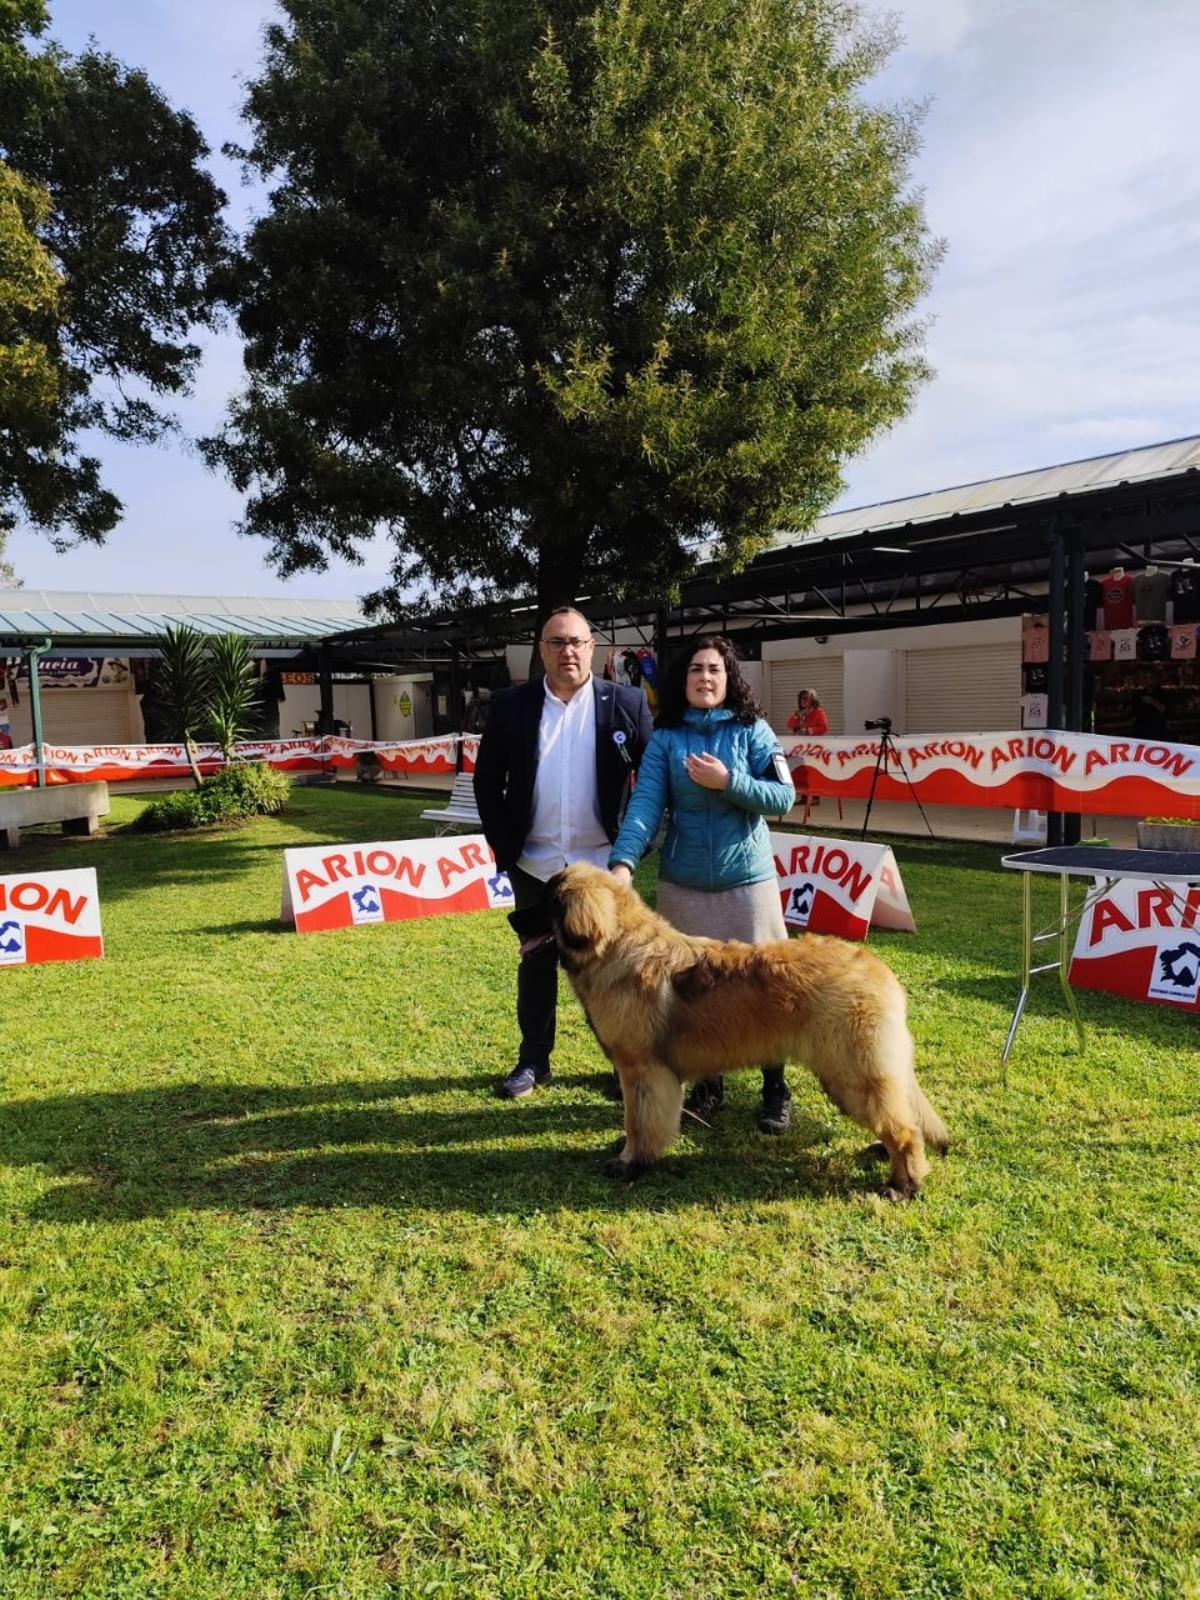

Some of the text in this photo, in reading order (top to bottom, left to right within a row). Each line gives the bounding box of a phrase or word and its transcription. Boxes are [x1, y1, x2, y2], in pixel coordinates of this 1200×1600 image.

[83, 747, 131, 763] ARION
[907, 740, 986, 769] ARION
[991, 736, 1076, 773] ARION
[1084, 743, 1195, 777] ARION
[296, 850, 426, 902] ARION
